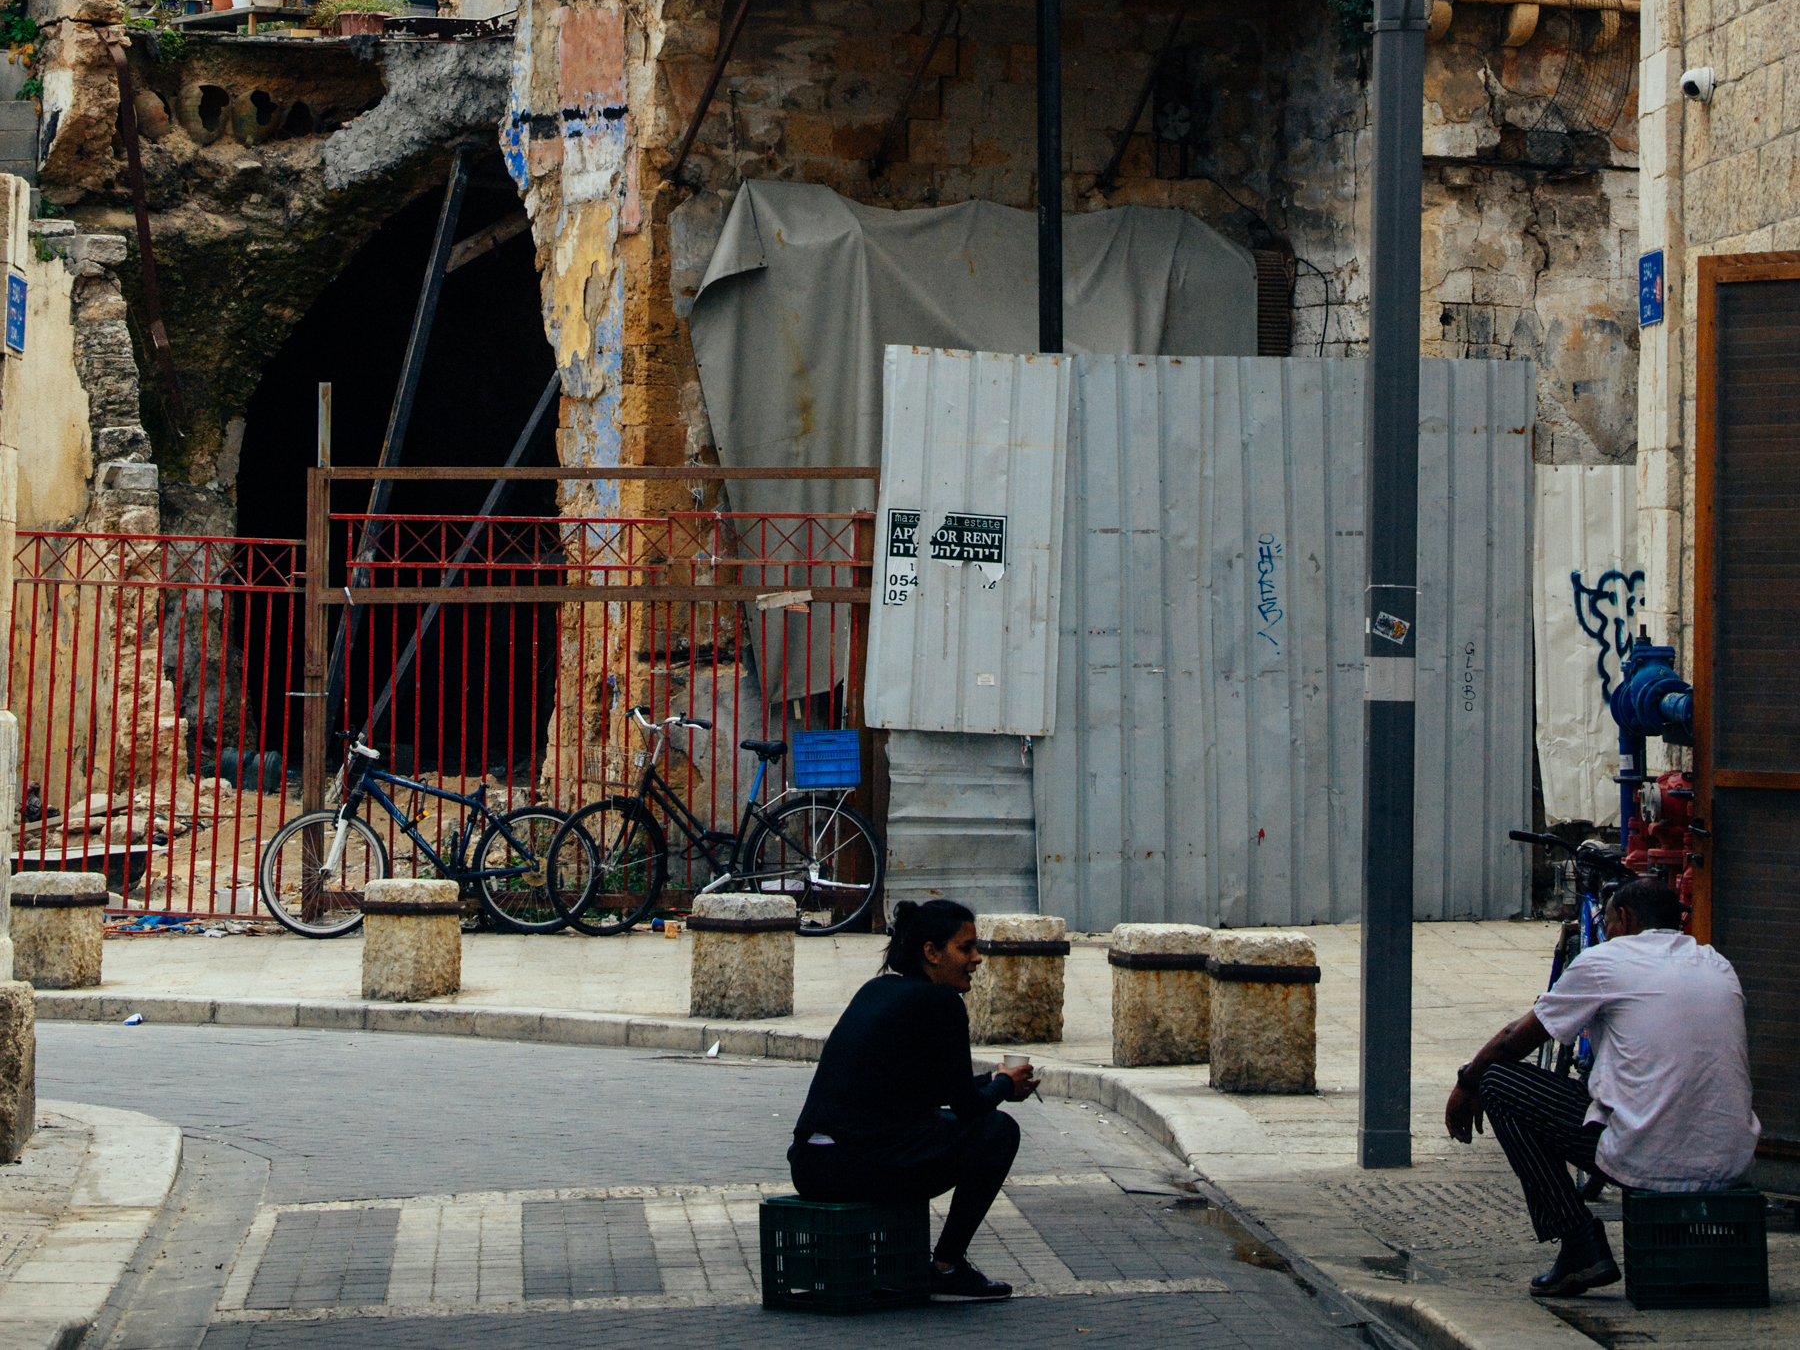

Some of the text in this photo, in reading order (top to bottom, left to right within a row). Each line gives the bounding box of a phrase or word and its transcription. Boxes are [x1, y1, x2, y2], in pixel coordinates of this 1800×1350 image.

[964, 518, 1001, 529] estate
[892, 526, 1002, 546] AP OR RENT
[963, 547, 1000, 560] דירה
[889, 574, 919, 587] 054
[888, 589, 908, 602] 05
